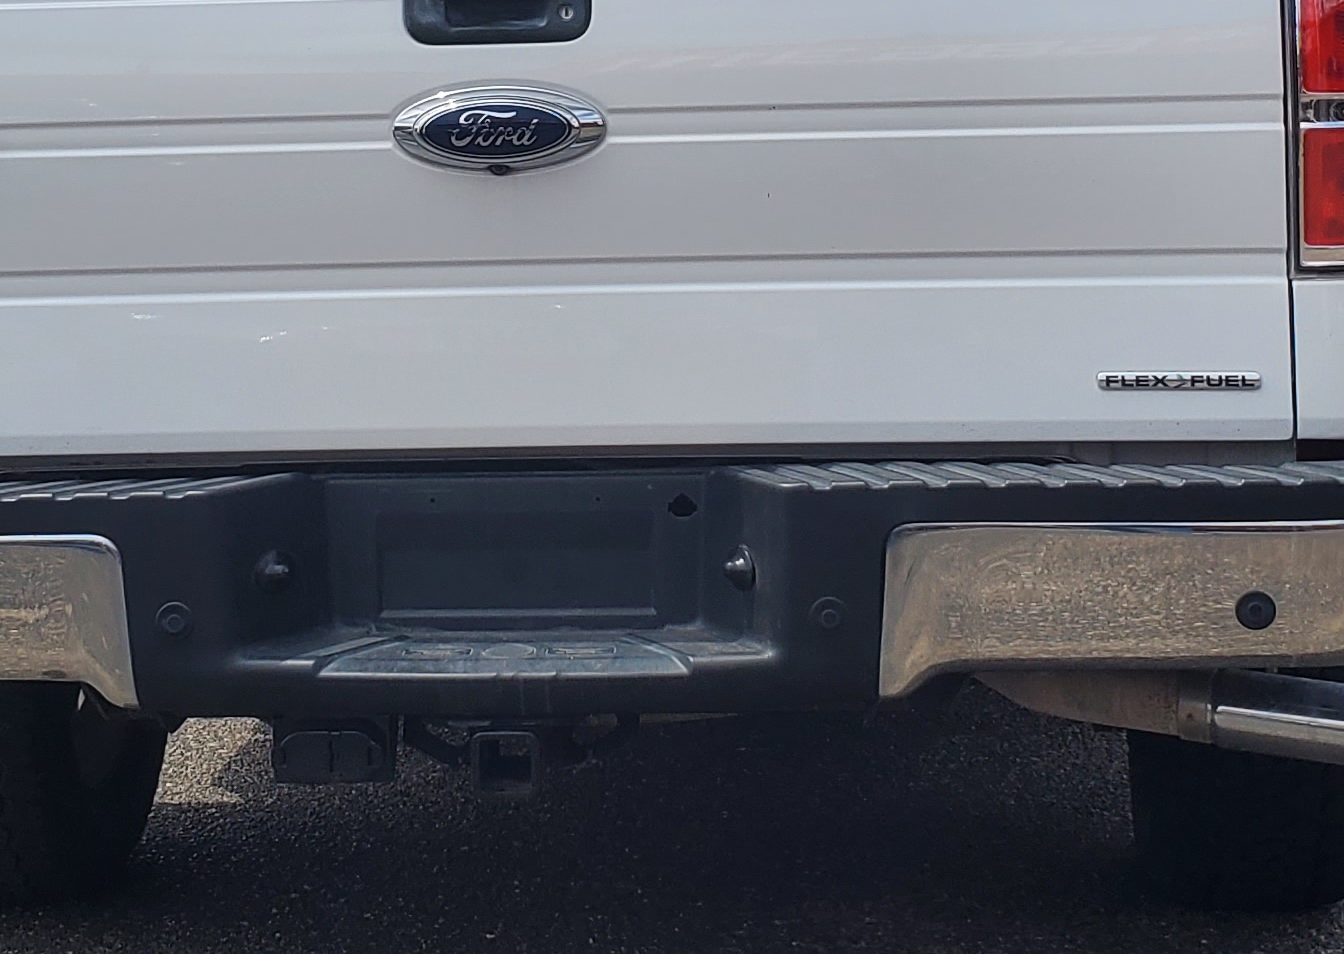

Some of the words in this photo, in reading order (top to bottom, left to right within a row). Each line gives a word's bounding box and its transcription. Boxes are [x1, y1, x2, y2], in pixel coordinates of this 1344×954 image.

[448, 109, 540, 147] Ford
[1105, 375, 1169, 388] FLEX
[1190, 375, 1256, 388] FUEL
